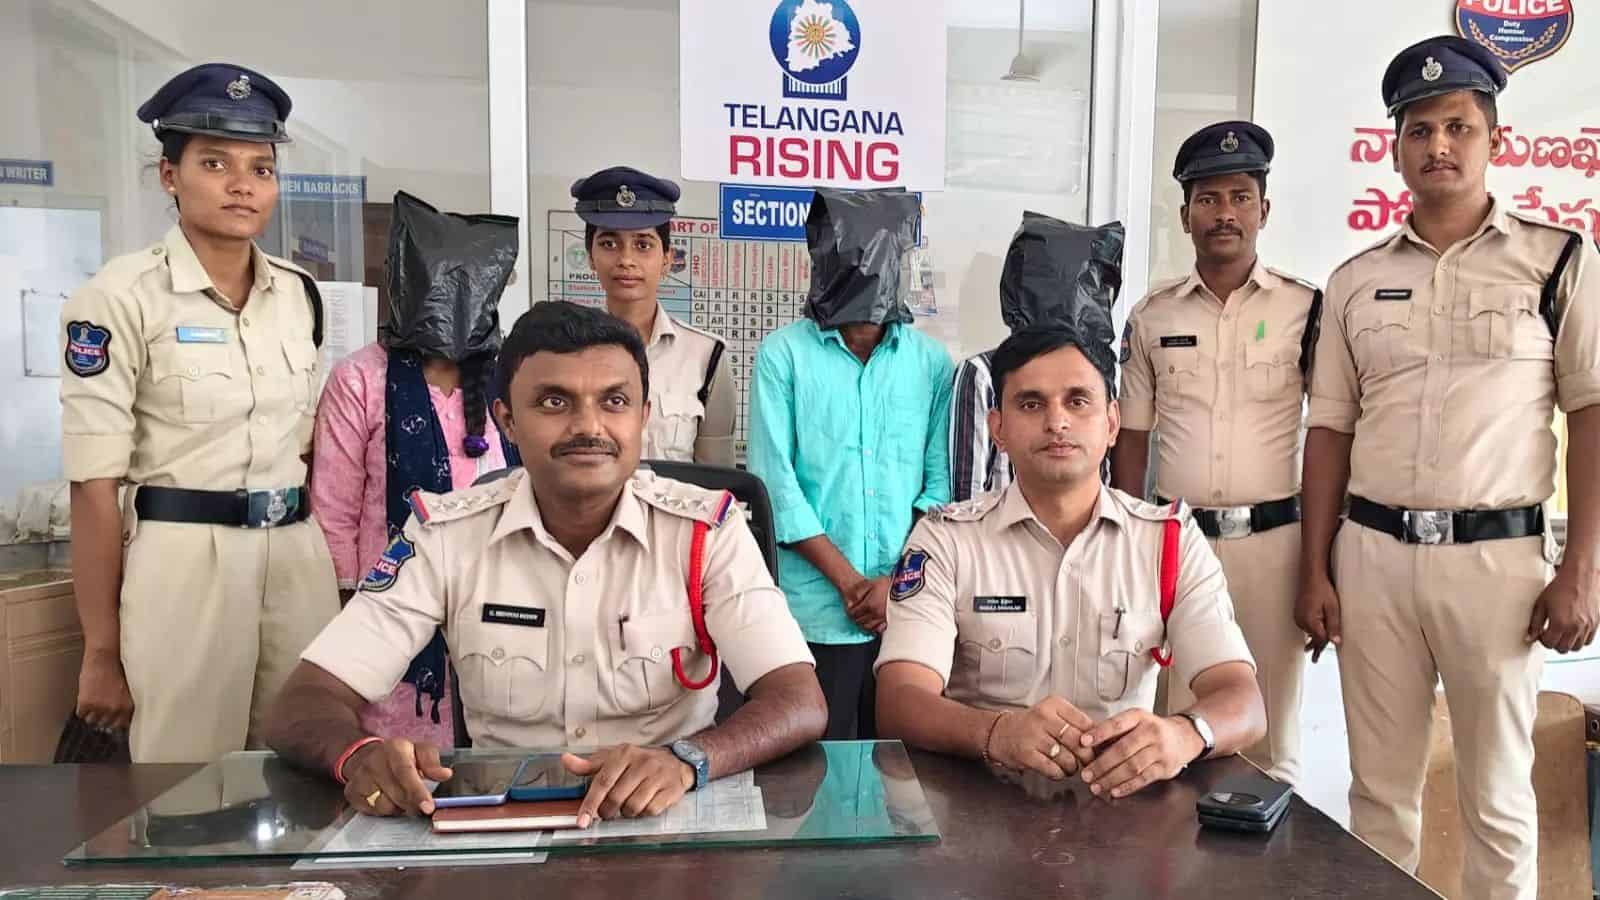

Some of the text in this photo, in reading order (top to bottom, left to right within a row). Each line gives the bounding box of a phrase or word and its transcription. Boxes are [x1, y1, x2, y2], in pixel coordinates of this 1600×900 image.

[723, 103, 904, 135] TELANGANA
[729, 134, 899, 182] RISING
[8, 166, 48, 181] WRITER
[303, 181, 360, 194] BARRACKS
[731, 200, 812, 228] SECTION
[700, 223, 718, 235] OF
[732, 330, 739, 339] R
[750, 330, 757, 339] R
